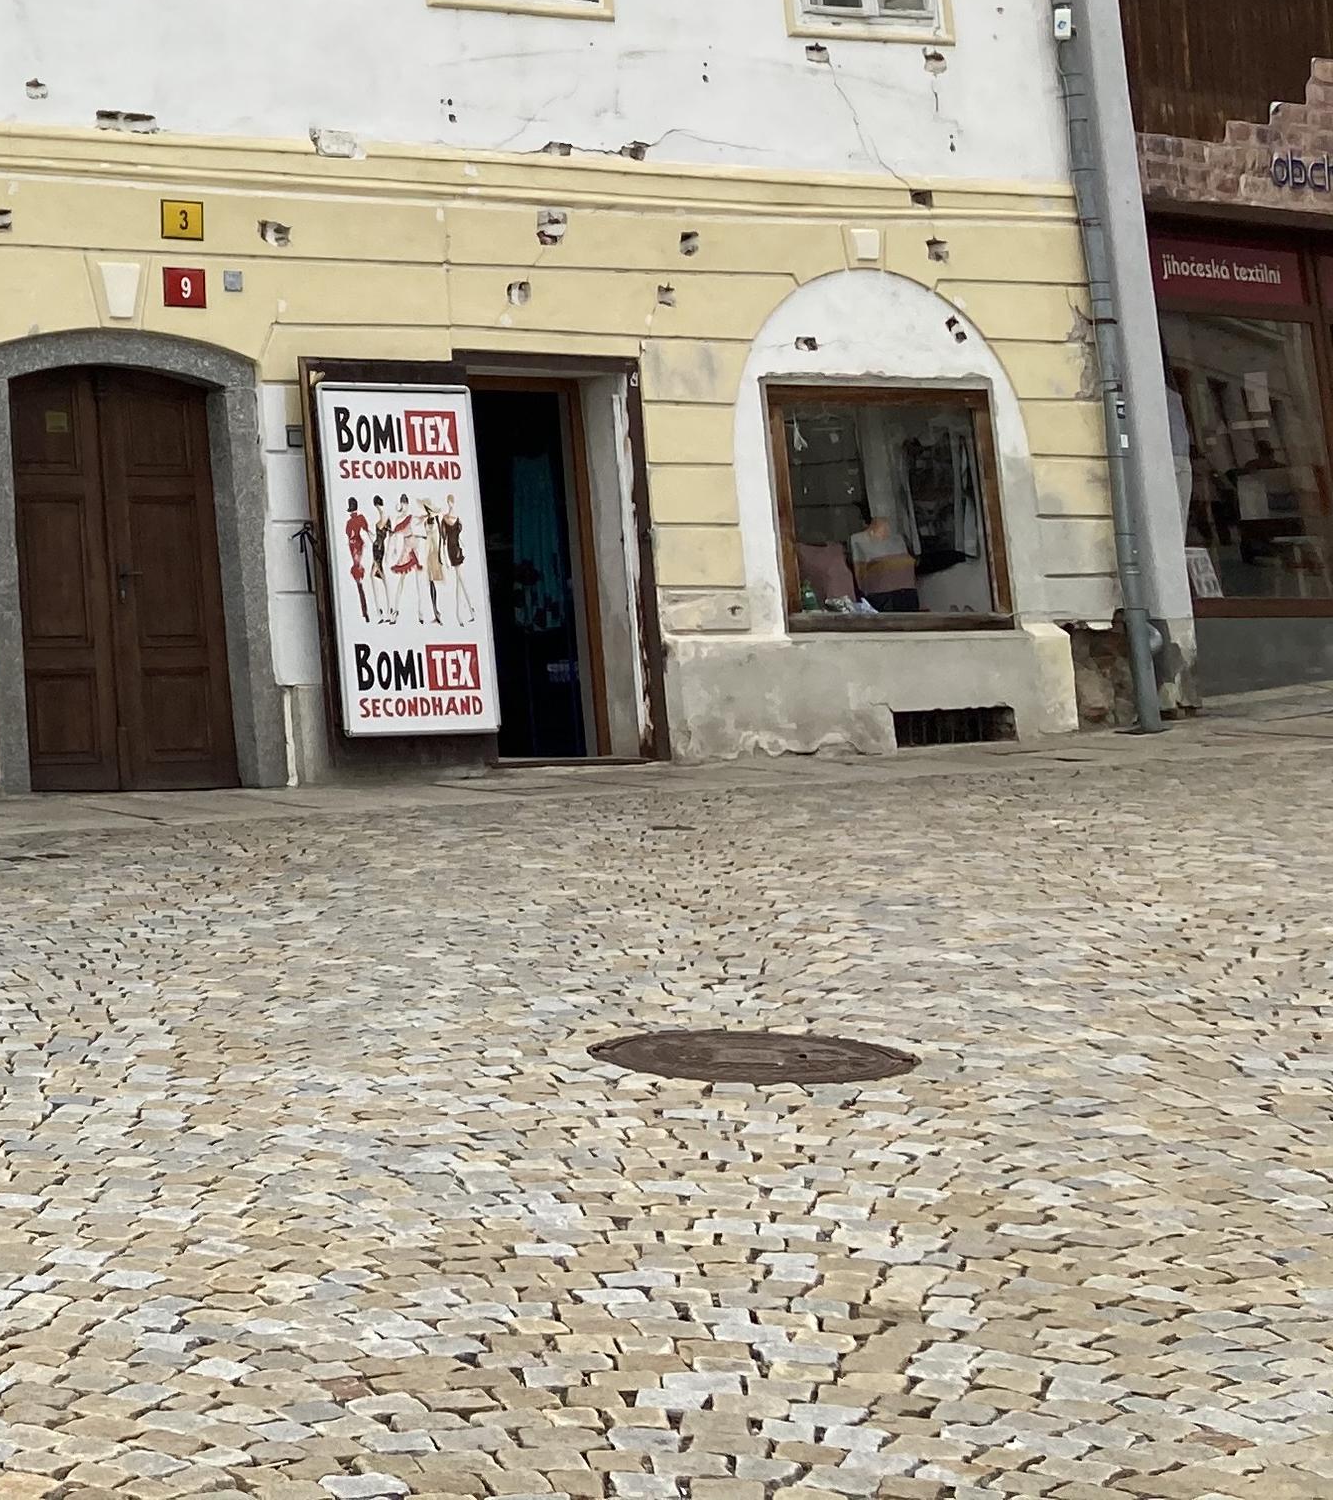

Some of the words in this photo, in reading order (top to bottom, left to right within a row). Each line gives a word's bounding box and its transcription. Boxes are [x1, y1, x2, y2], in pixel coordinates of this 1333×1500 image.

[179, 209, 189, 230] 3
[1161, 253, 1230, 280] jihočeská
[180, 276, 192, 299] 9
[339, 459, 461, 480] SECONDHAND
[359, 695, 483, 718] SECONDHAND
